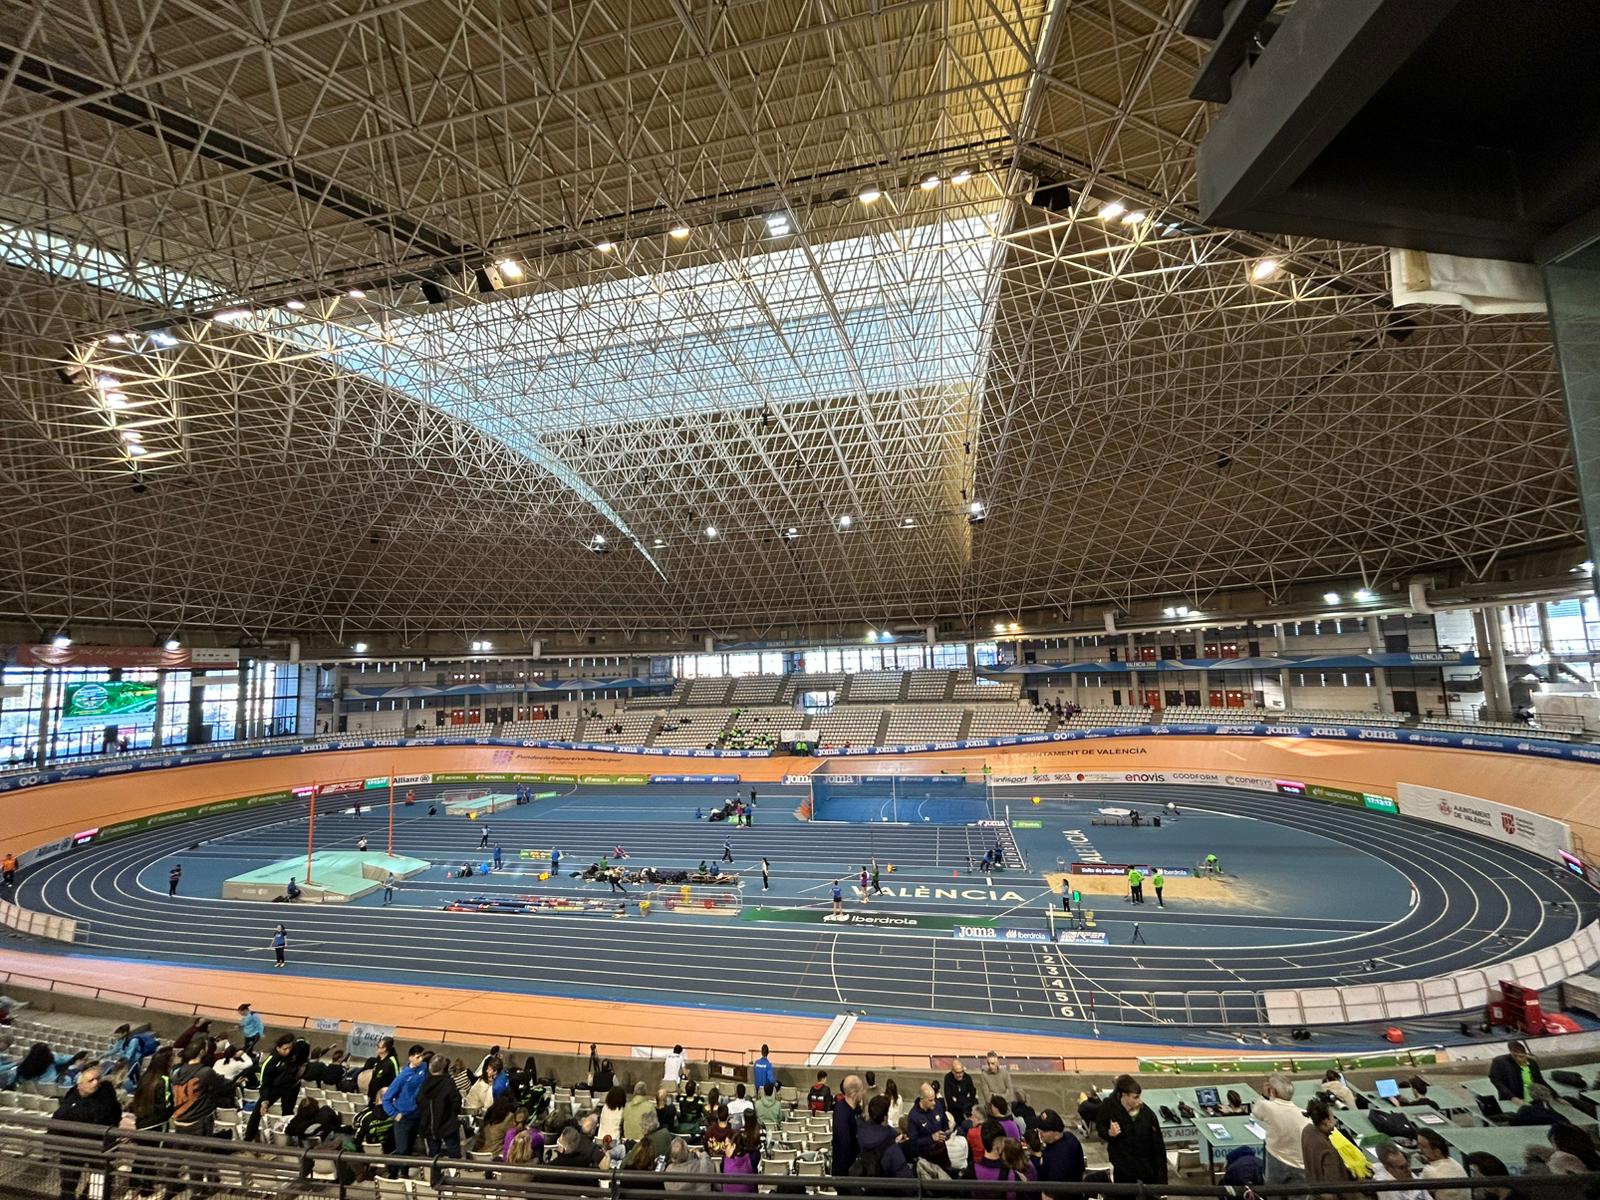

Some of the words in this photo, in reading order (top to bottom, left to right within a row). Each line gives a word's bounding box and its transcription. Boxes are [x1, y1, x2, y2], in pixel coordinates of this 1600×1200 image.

[1125, 773, 1165, 783] enovis
[851, 885, 1026, 902] VALÈNCIA
[1041, 945, 1048, 953] 1
[1043, 956, 1056, 964] 2
[1046, 966, 1059, 975] 3
[1051, 979, 1065, 989] 4
[1055, 992, 1069, 1002] 5
[1061, 1006, 1075, 1017] 6
